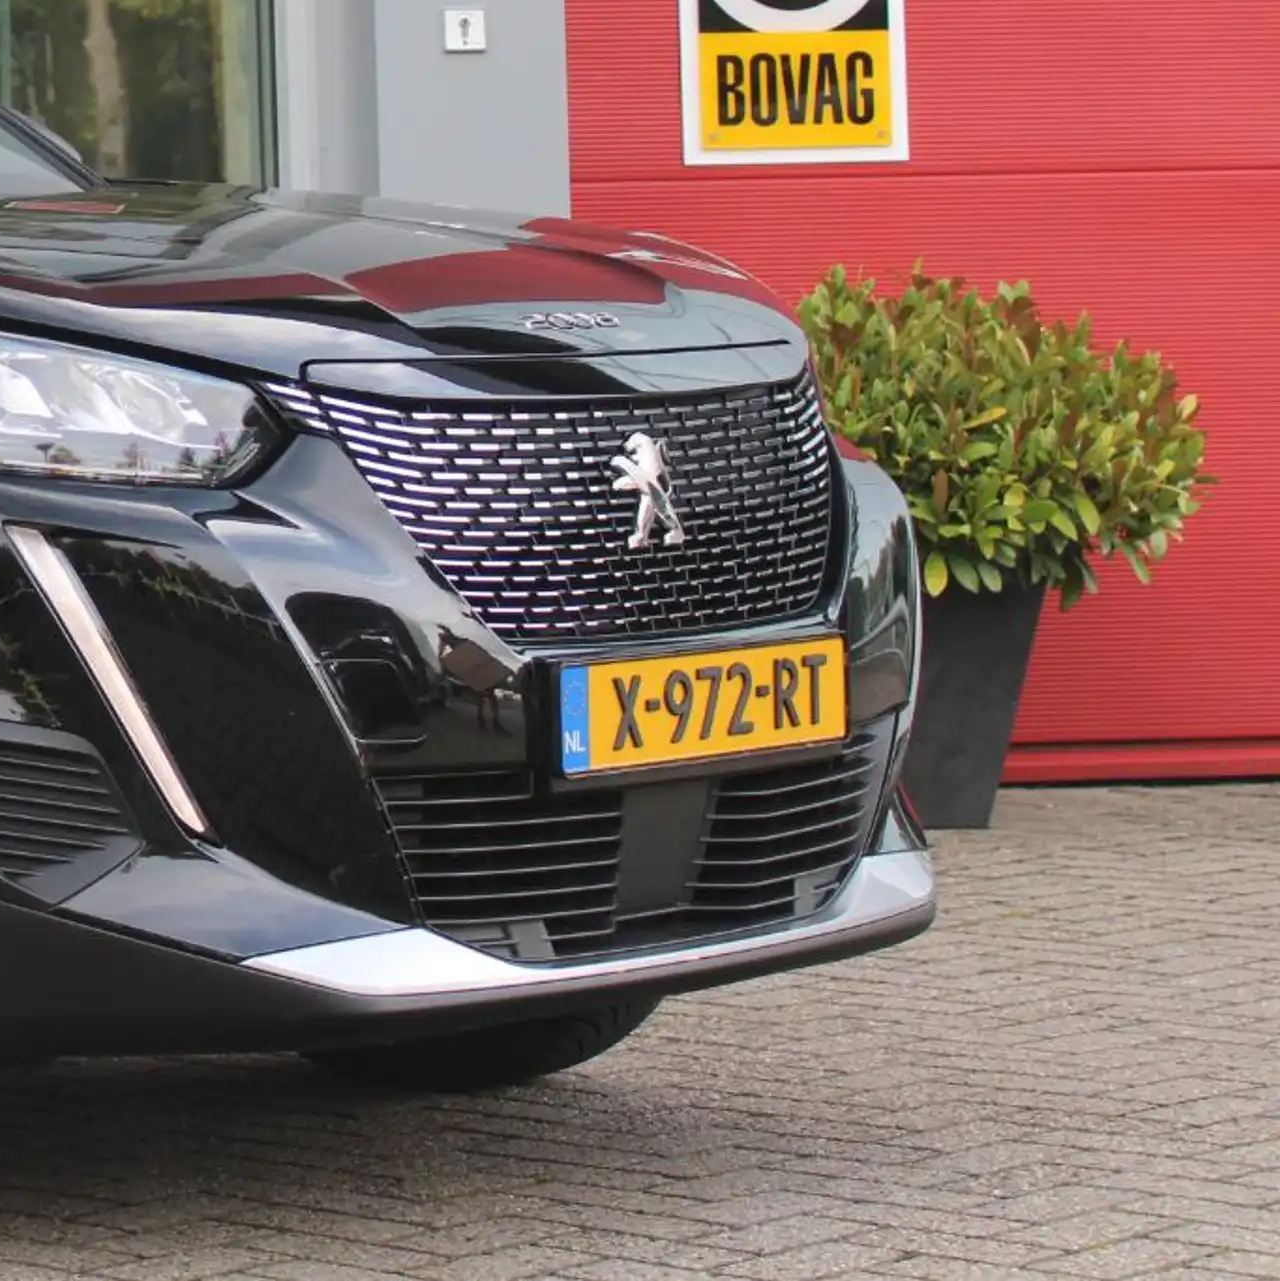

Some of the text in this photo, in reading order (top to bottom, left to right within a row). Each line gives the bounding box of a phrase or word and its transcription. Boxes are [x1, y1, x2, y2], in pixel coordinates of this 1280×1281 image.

[715, 51, 875, 126] BOVAG
[611, 653, 828, 751] X-972-RT
[563, 731, 586, 754] NL
